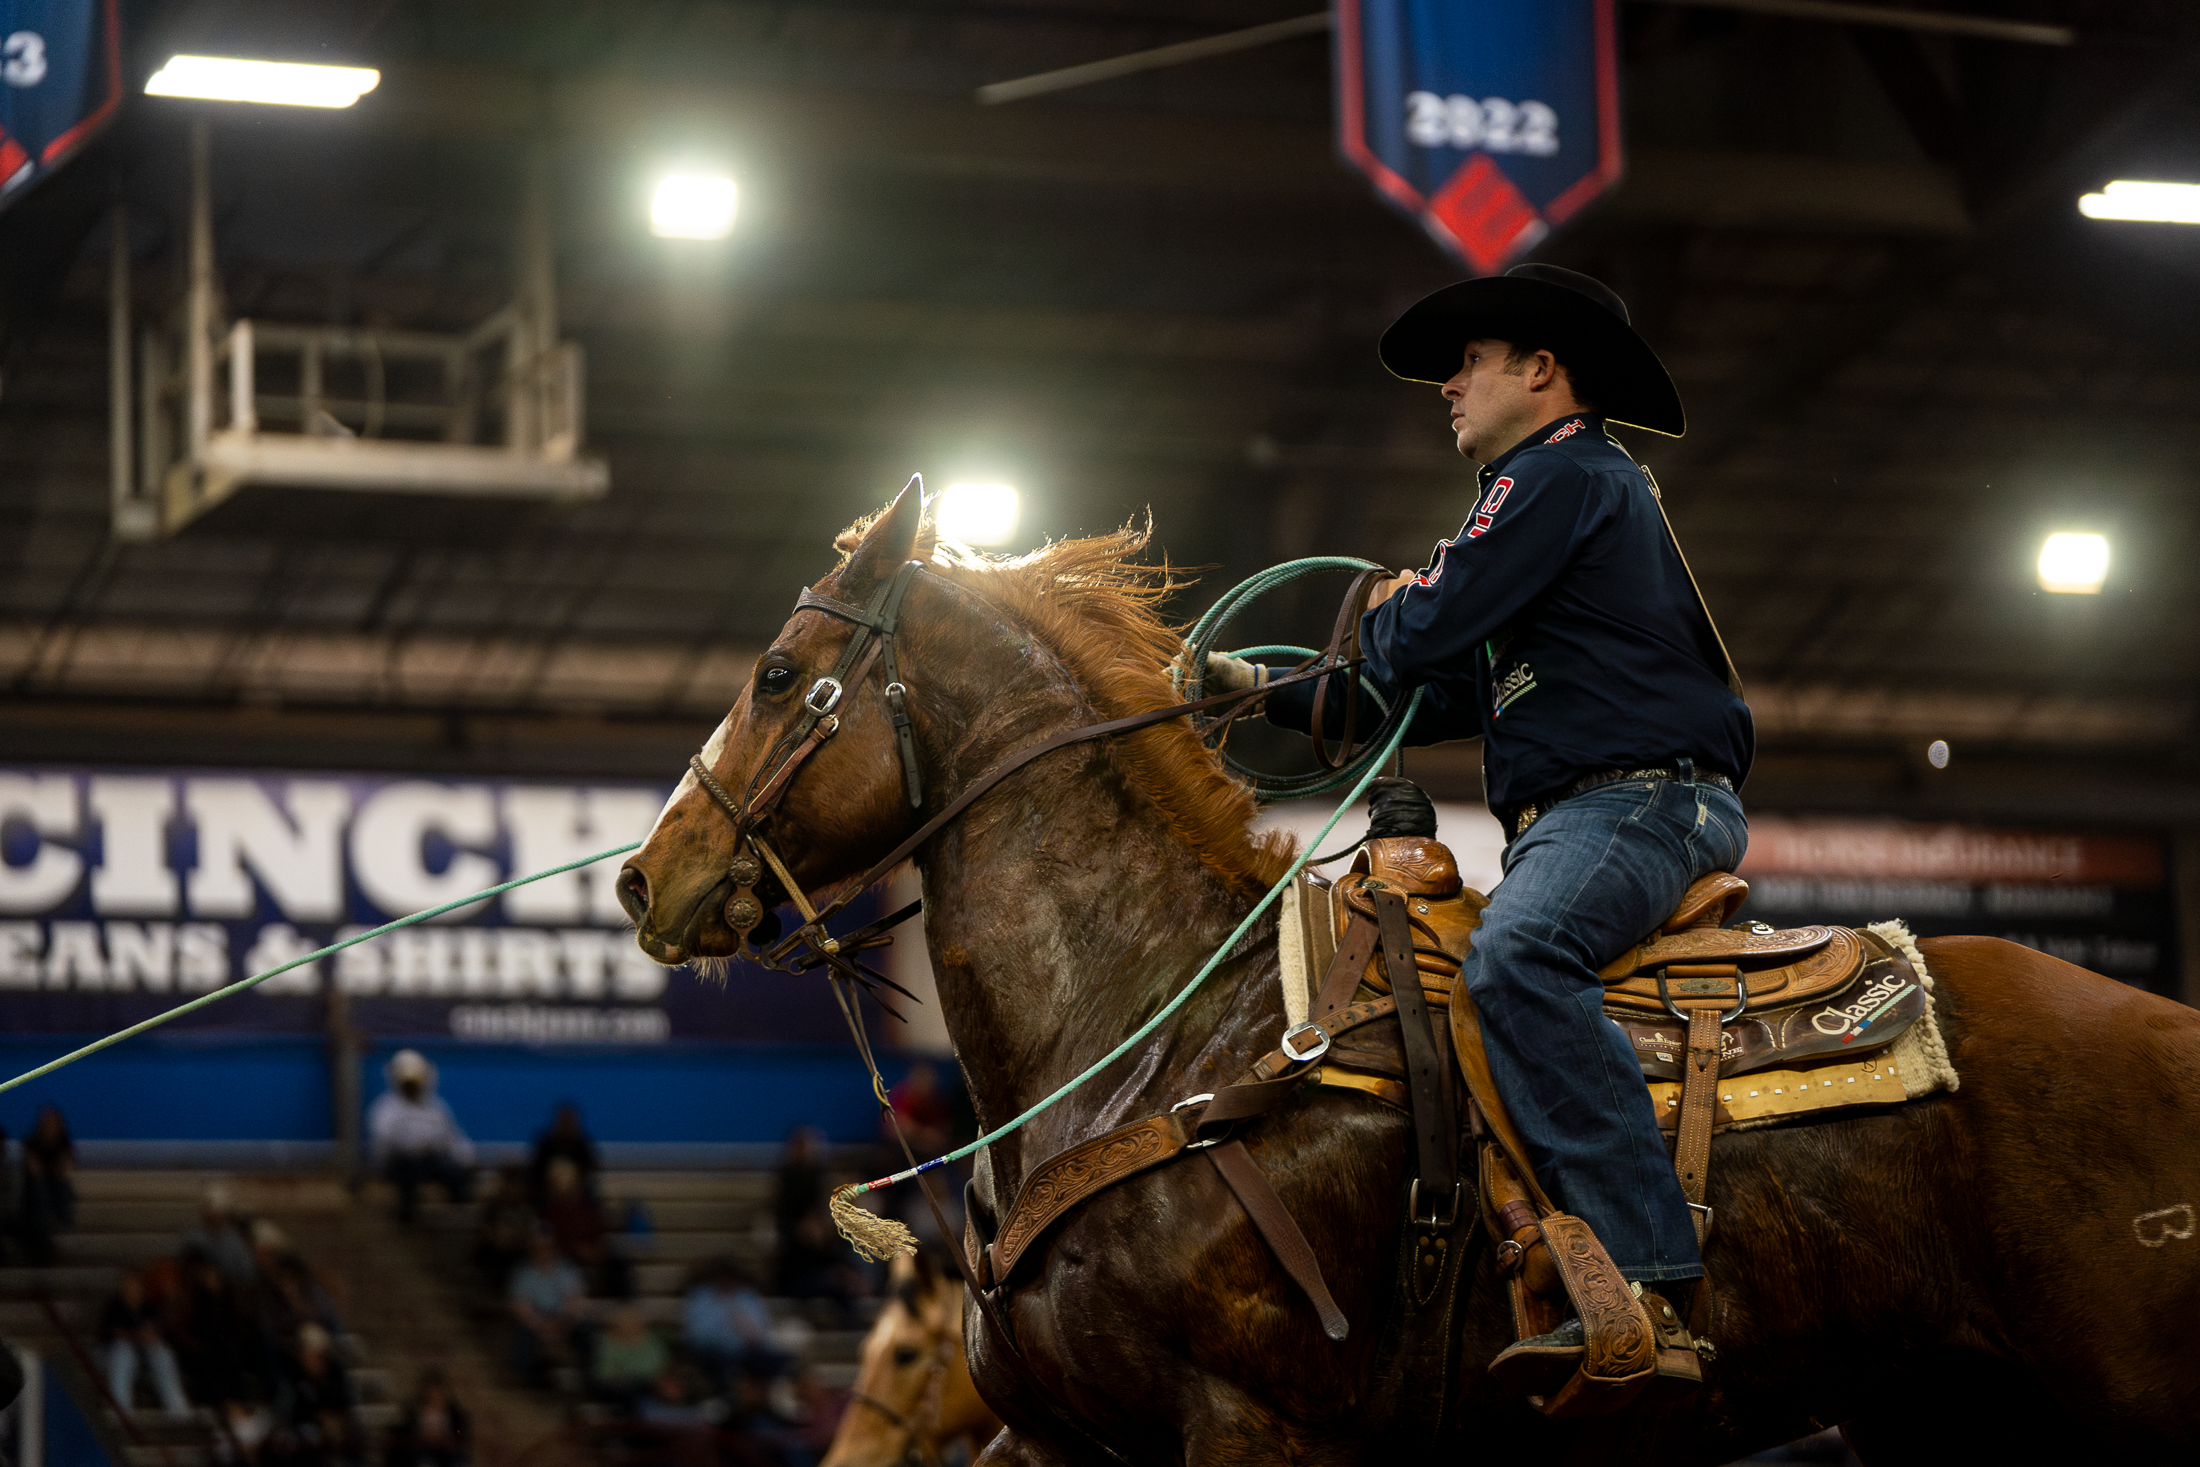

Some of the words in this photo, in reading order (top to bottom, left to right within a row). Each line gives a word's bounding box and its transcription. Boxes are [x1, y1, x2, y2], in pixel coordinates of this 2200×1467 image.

[0, 28, 48, 88] 3
[1404, 90, 1560, 157] 2022
[1543, 419, 1586, 445] CH
[0, 774, 663, 922] CINCH
[244, 922, 322, 997] &
[333, 925, 668, 1000] SHIRTS
[1811, 974, 1906, 1035] Classic
